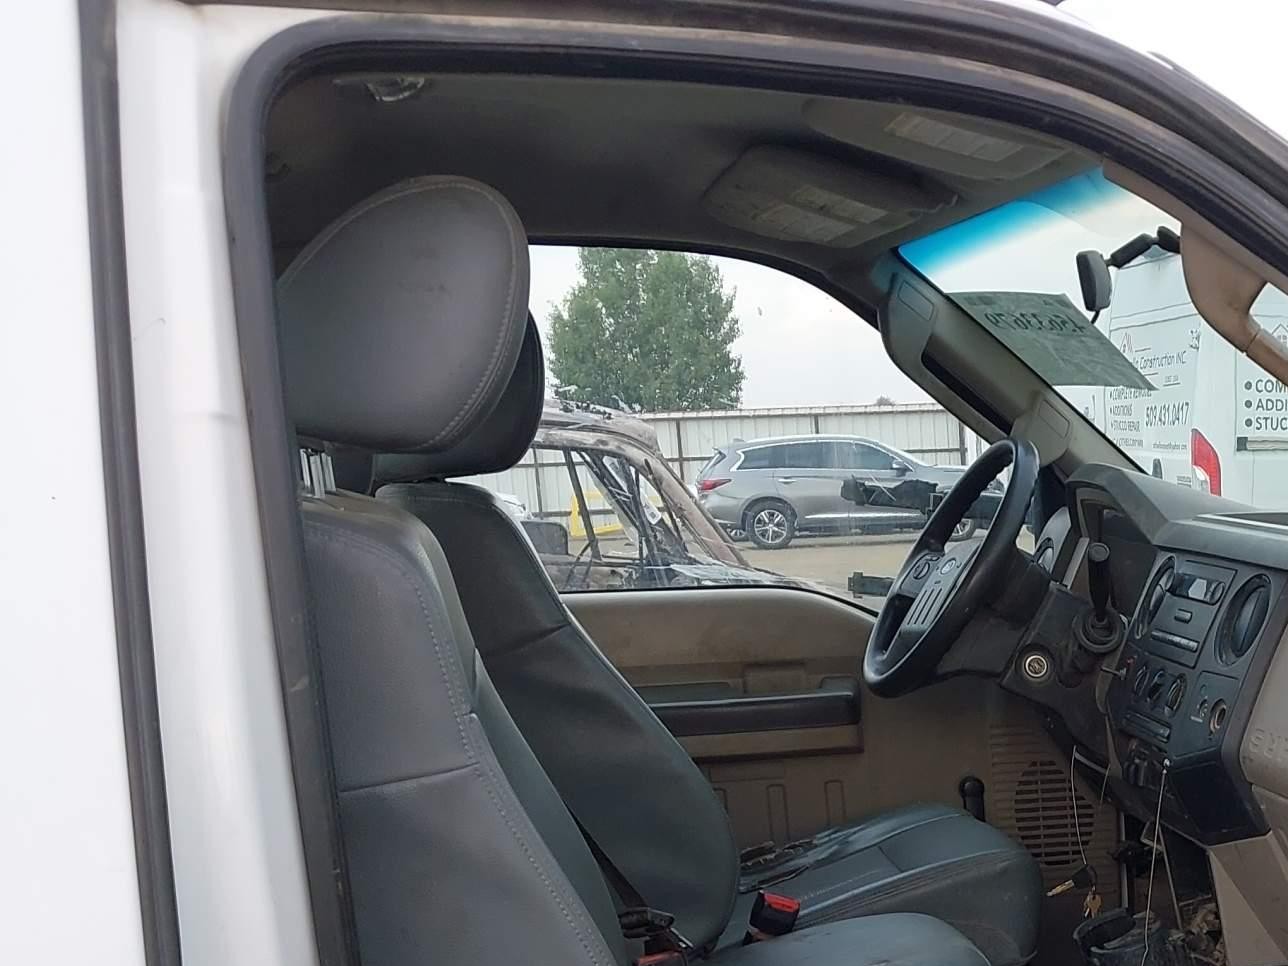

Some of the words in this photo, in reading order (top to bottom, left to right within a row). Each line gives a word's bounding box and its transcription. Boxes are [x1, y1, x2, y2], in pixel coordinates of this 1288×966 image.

[1140, 352, 1175, 370] Construction
[1176, 350, 1187, 364] INC
[1145, 402, 1190, 427] 509.431.0417
